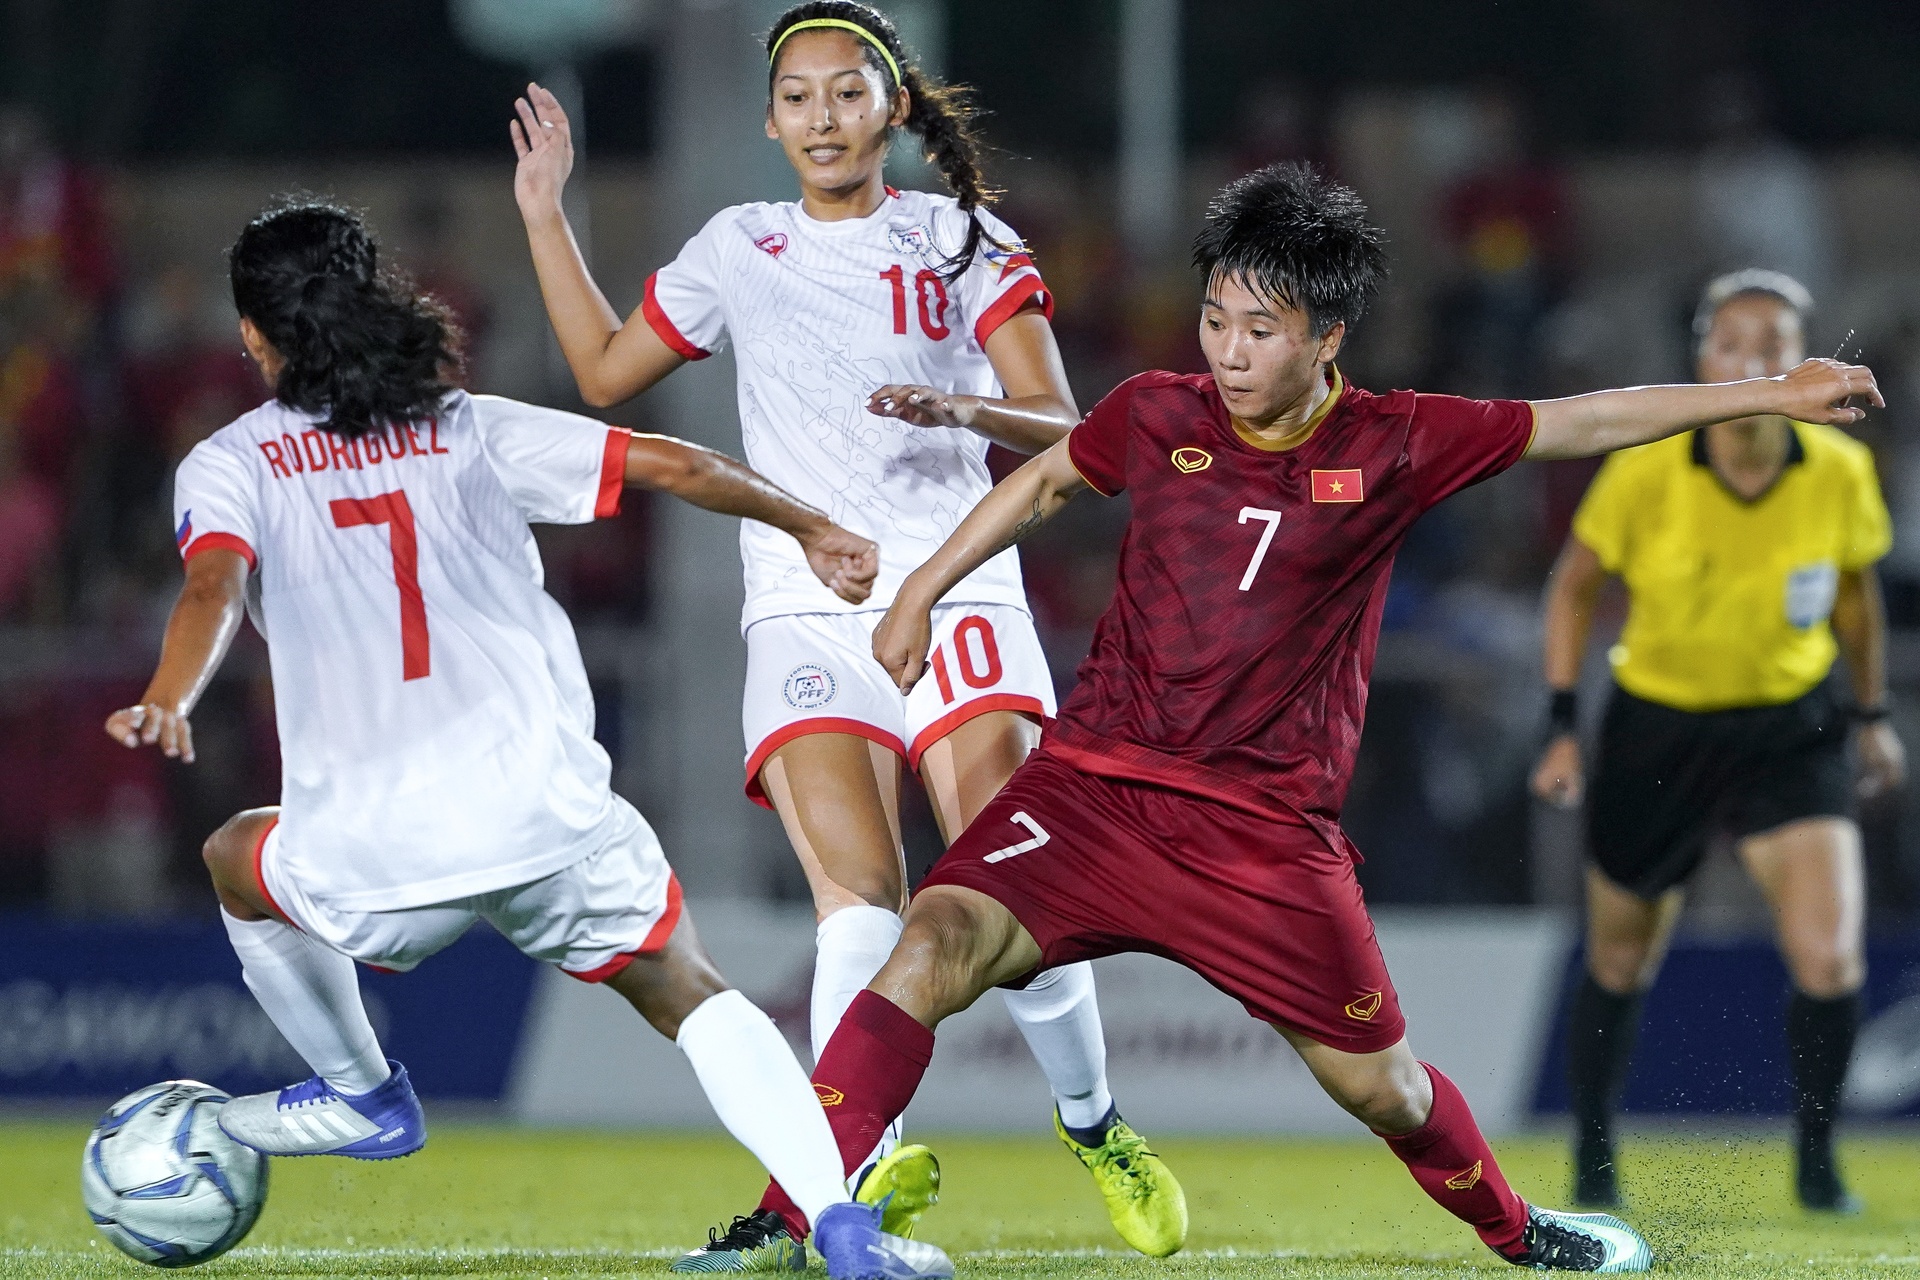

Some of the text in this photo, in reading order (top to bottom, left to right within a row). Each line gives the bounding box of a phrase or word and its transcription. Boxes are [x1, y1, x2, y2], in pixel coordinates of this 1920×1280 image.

[879, 264, 950, 341] 10
[260, 416, 449, 478] RODRIGUEZ
[329, 489, 429, 681] 7
[1237, 506, 1282, 592] 7
[798, 689, 825, 699] PFF
[931, 615, 1003, 705] 10
[982, 811, 1051, 864] 7
